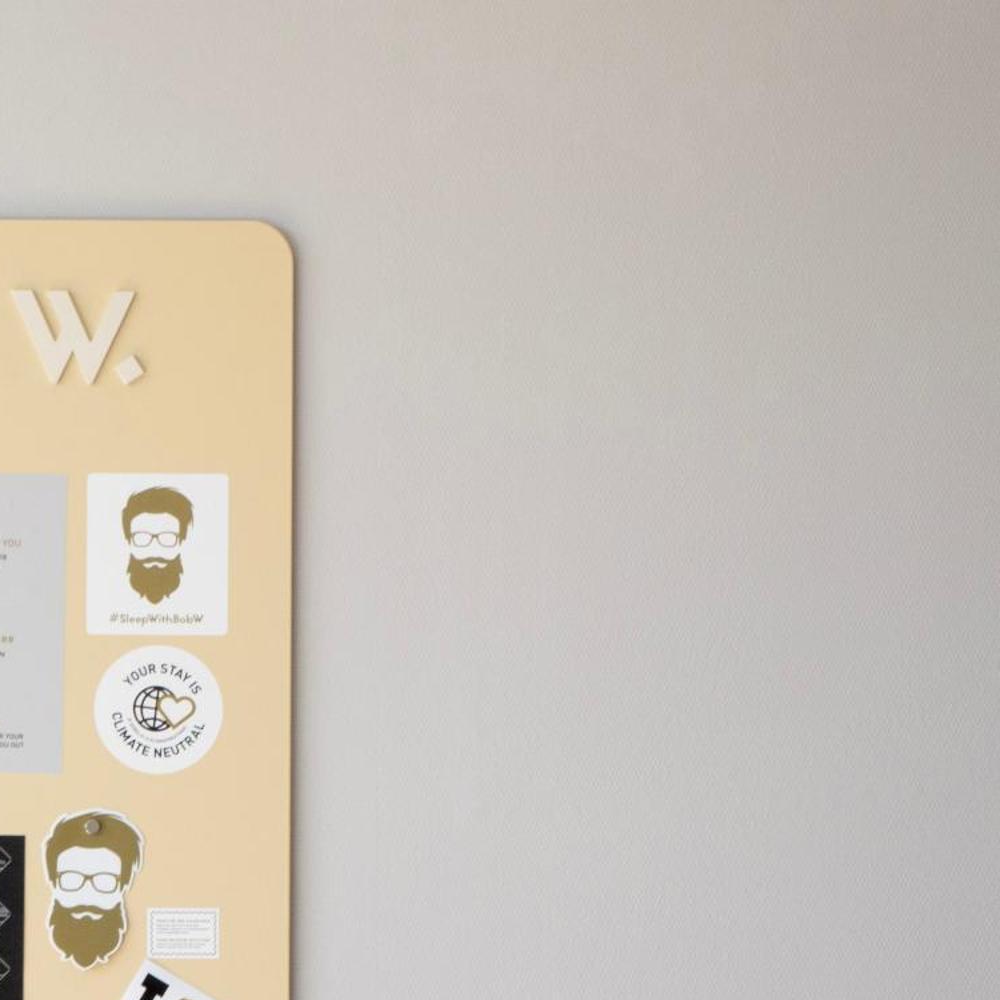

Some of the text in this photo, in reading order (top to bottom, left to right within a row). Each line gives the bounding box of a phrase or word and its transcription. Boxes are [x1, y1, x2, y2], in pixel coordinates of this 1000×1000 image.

[10, 289, 146, 385] W.
[3, 536, 22, 547] YOU
[122, 663, 202, 695] YOUR STAY IS
[112, 712, 150, 757] CLIMATE
[153, 723, 206, 758] NEUTRAL
